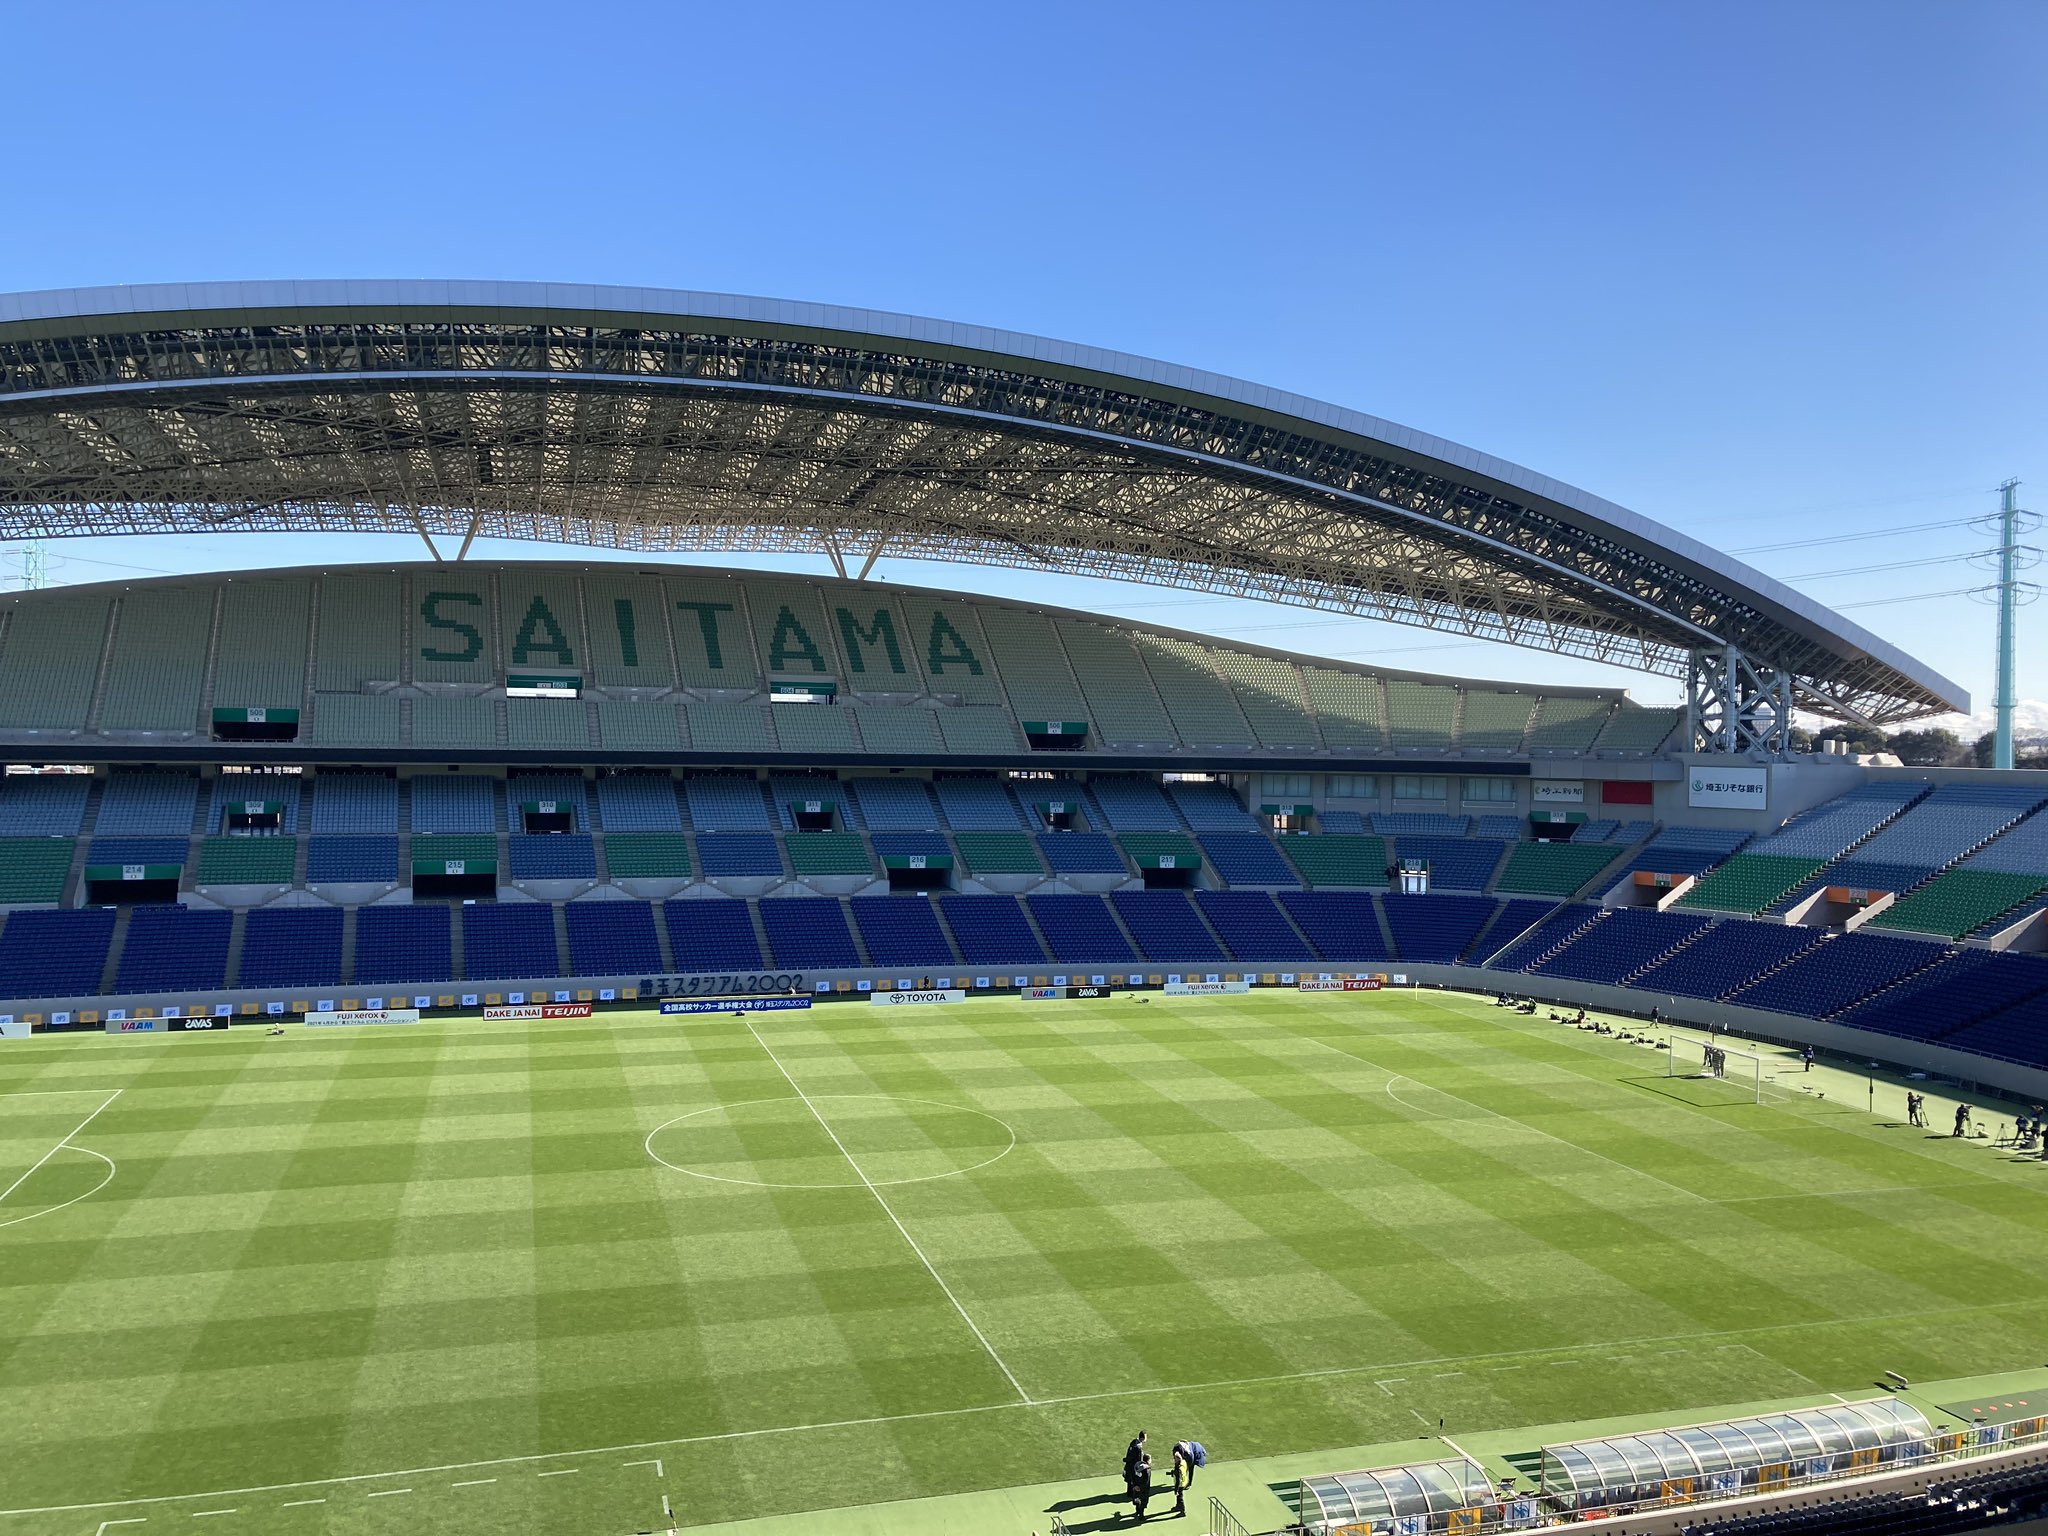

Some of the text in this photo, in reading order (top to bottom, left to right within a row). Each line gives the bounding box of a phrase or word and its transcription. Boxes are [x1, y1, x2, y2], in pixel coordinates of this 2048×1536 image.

[420, 592, 983, 675] SAITAMA
[1705, 783, 1763, 793] 埼玉りそな銀行
[639, 974, 803, 995] 埼玉スタジアム2002
[1346, 981, 1379, 989] TEIJIN
[906, 993, 946, 1002] TOYOTA
[1032, 990, 1056, 998] VAAM
[1078, 989, 1098, 997] SAVAS
[664, 1001, 752, 1012] 全国高校サッカー選手権大会
[486, 1008, 540, 1018] DAKE JA NAI
[545, 1007, 588, 1016] TEIJIN
[121, 1022, 153, 1030] VAAM
[185, 1018, 213, 1029] SAVAS
